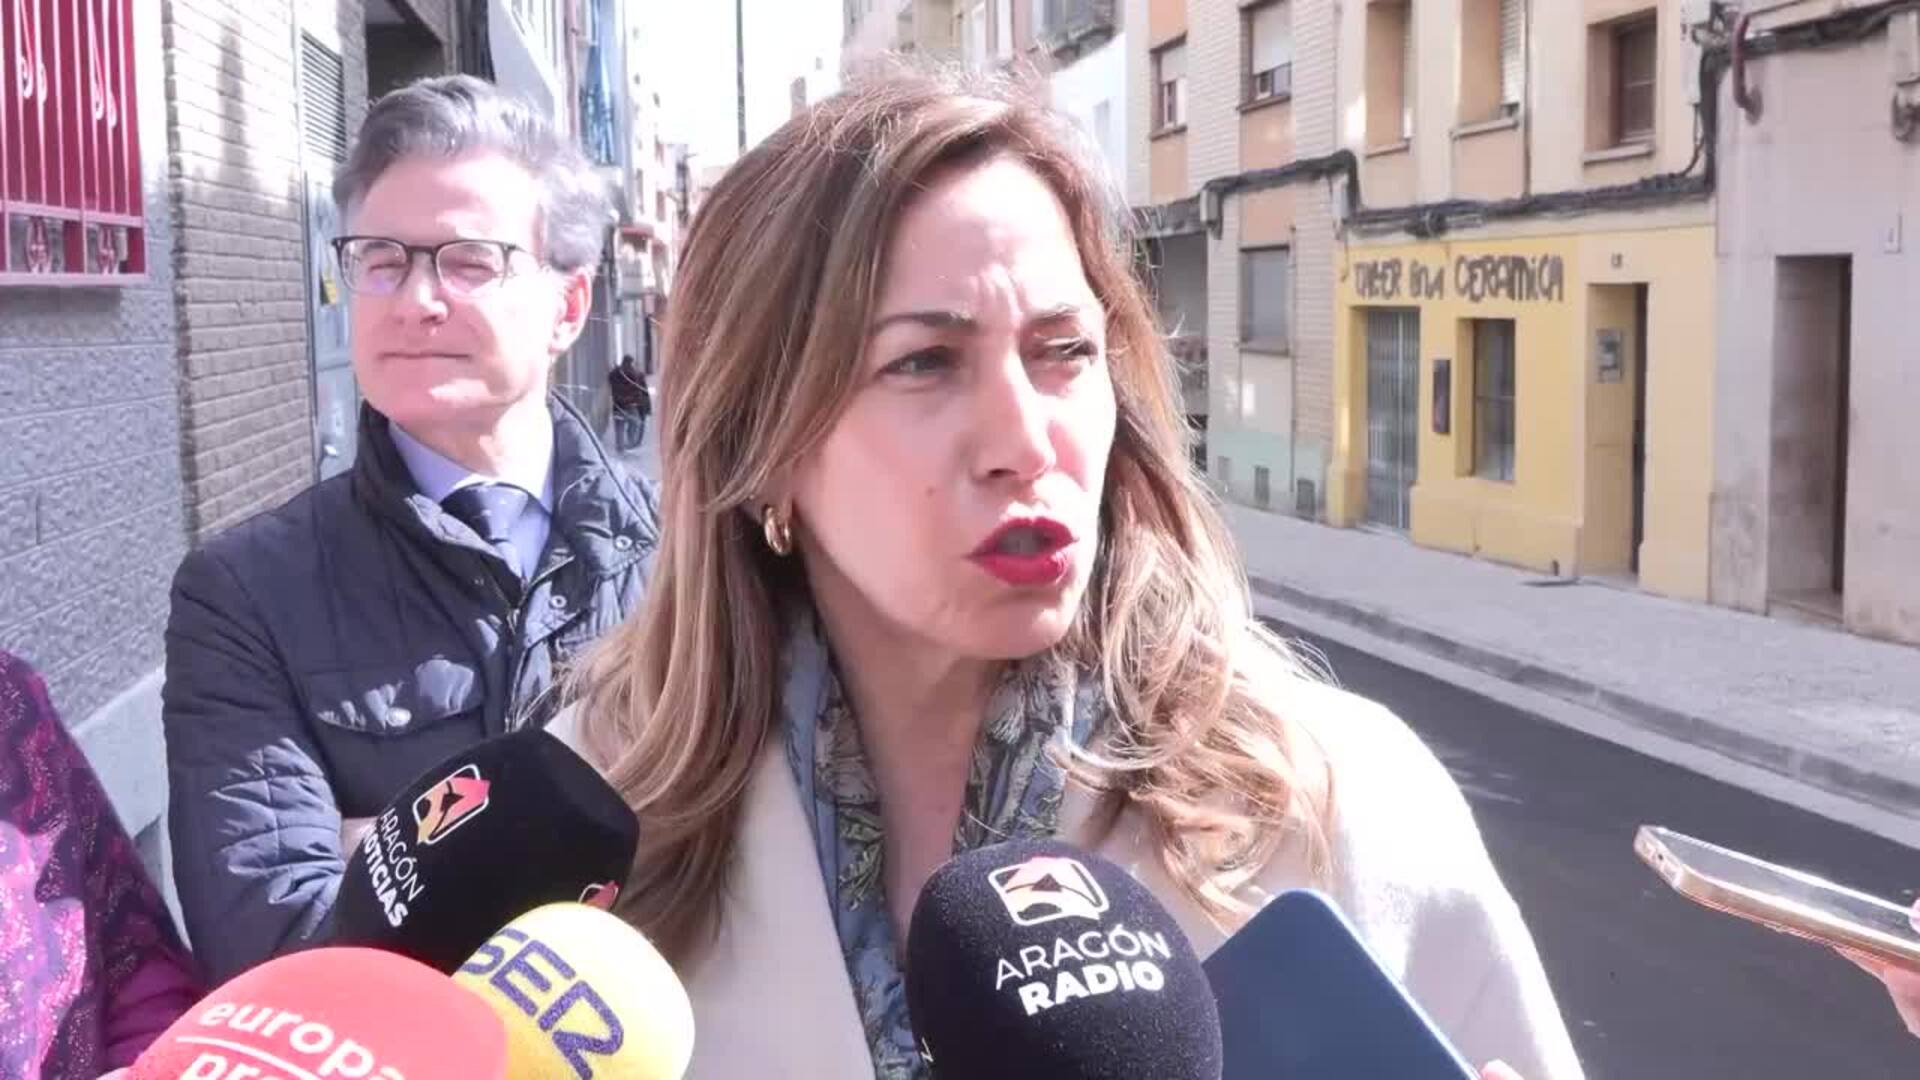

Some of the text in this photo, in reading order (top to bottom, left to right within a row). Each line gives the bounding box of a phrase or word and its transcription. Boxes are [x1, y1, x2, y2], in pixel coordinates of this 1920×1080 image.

[380, 807, 425, 902] ARAGÓN
[995, 923, 1172, 991] ARAGÓN
[1017, 960, 1165, 1016] RADIO
[458, 927, 624, 1080] SER
